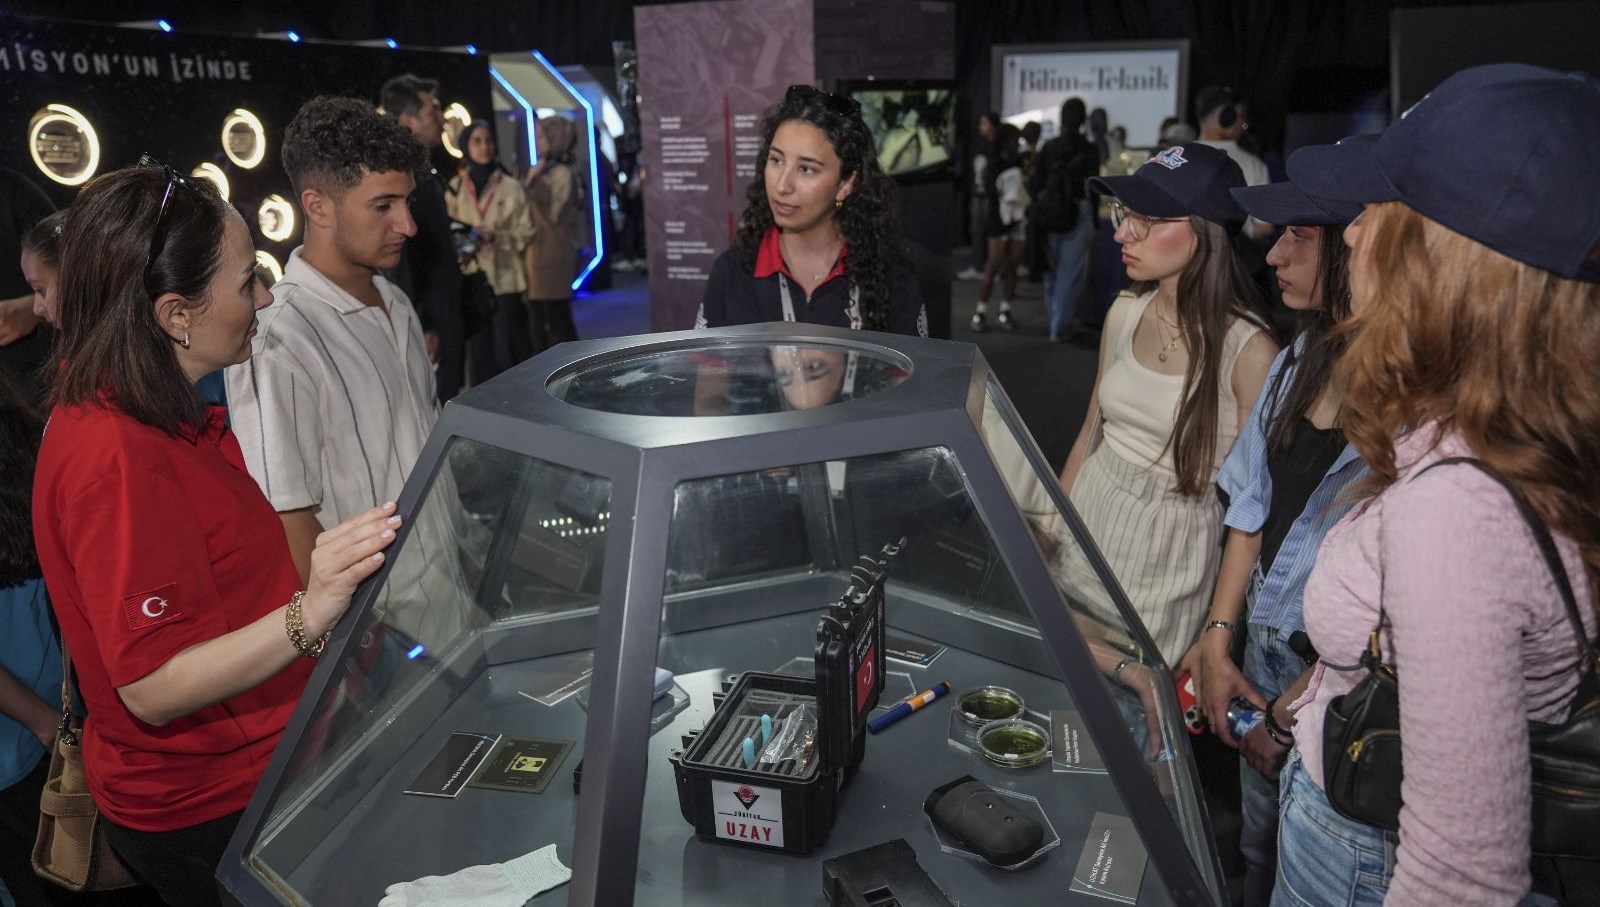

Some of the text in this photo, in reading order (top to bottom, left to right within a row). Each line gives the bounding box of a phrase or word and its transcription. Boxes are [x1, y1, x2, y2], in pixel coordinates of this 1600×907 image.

[1020, 68, 1079, 92] Bilim
[1091, 65, 1169, 91] Teknik
[734, 811, 761, 819] TÜBİTAK
[726, 821, 771, 841] UZAY
